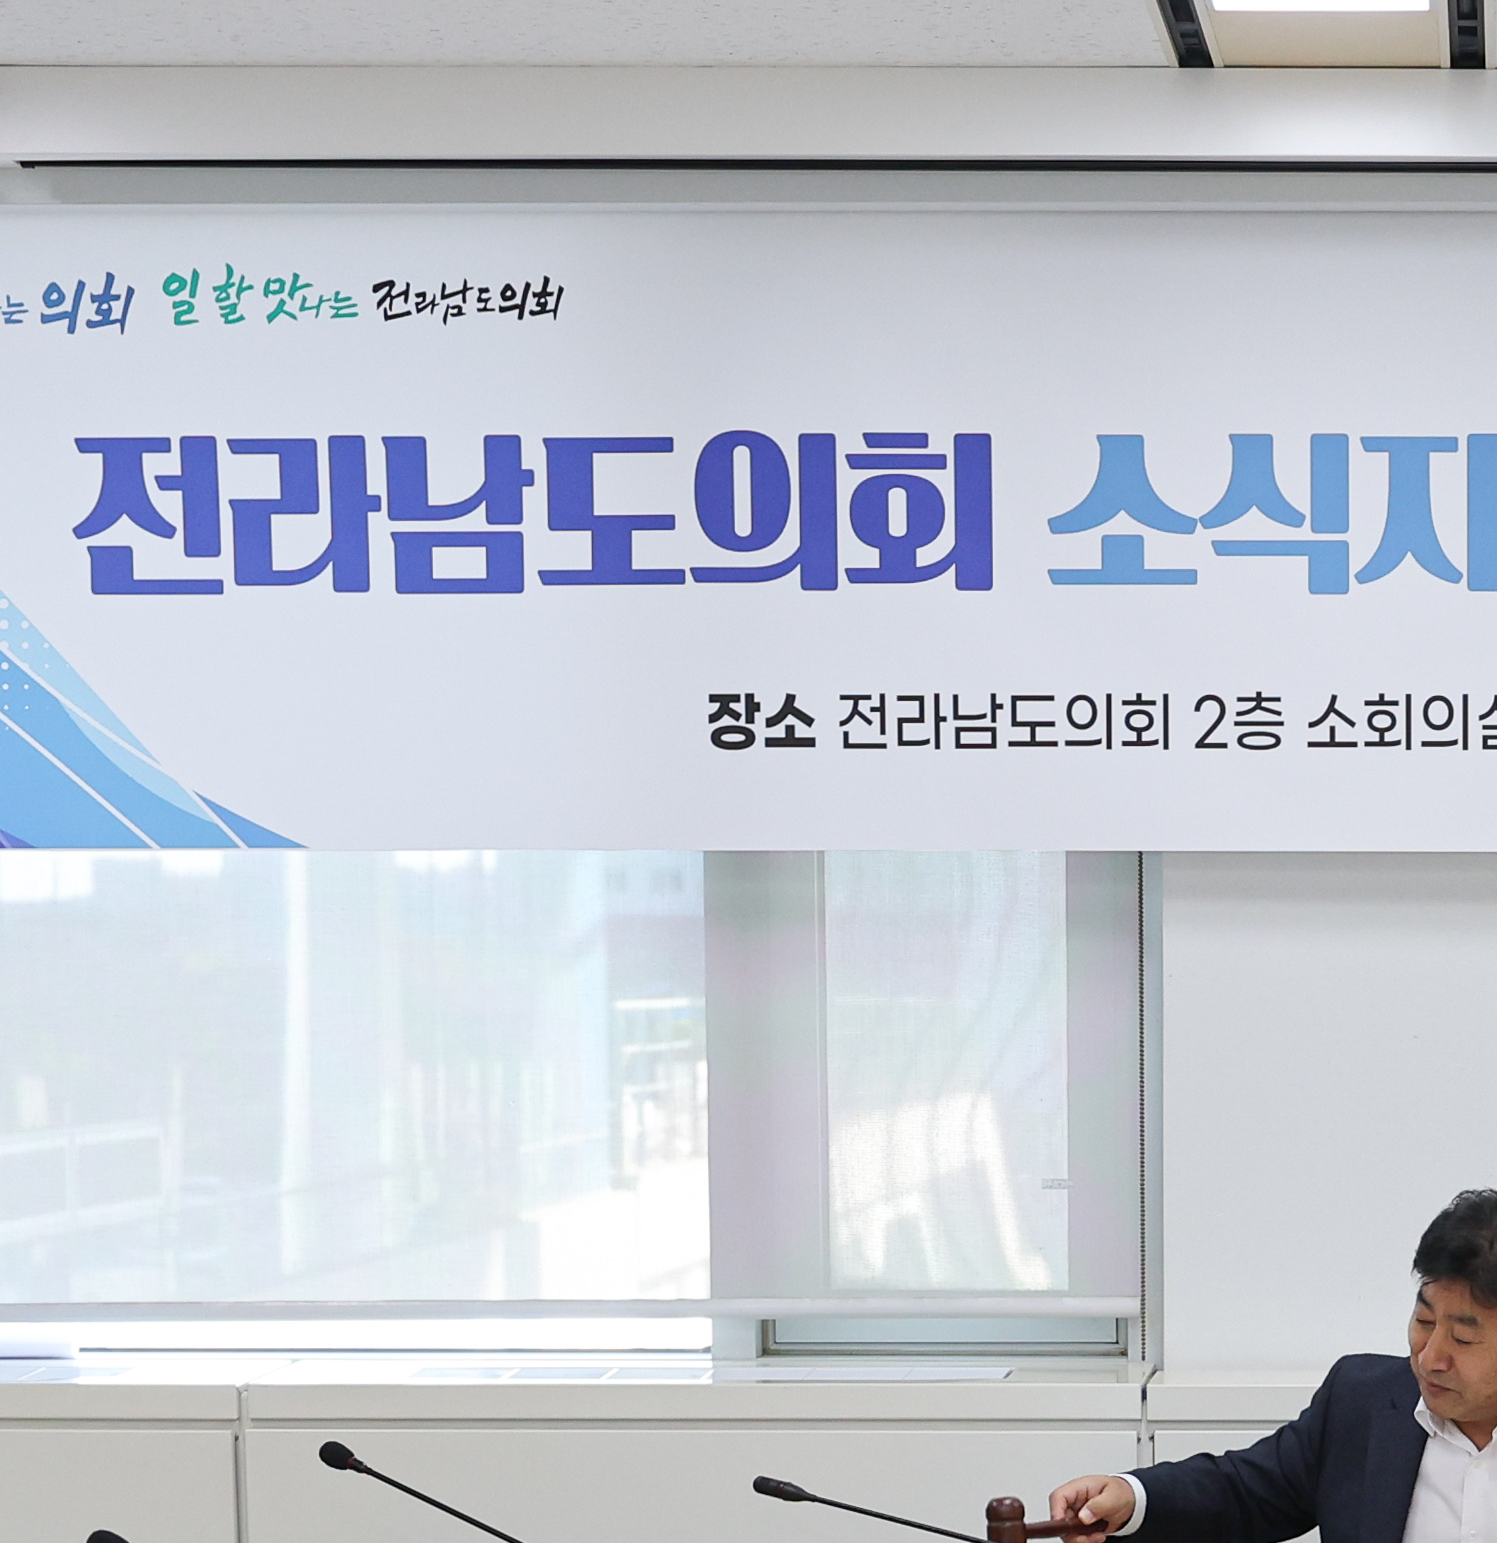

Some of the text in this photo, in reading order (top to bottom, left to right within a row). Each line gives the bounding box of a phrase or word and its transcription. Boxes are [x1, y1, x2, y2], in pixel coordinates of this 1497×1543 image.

[41, 272, 135, 335] 의회
[263, 272, 359, 324] 맛나는
[372, 275, 564, 326] 전라남도의회
[72, 430, 993, 595] 전라남도의회
[708, 693, 816, 750] 장소
[839, 693, 1169, 750] 전라남도의회
[1194, 691, 1284, 750] 2층
